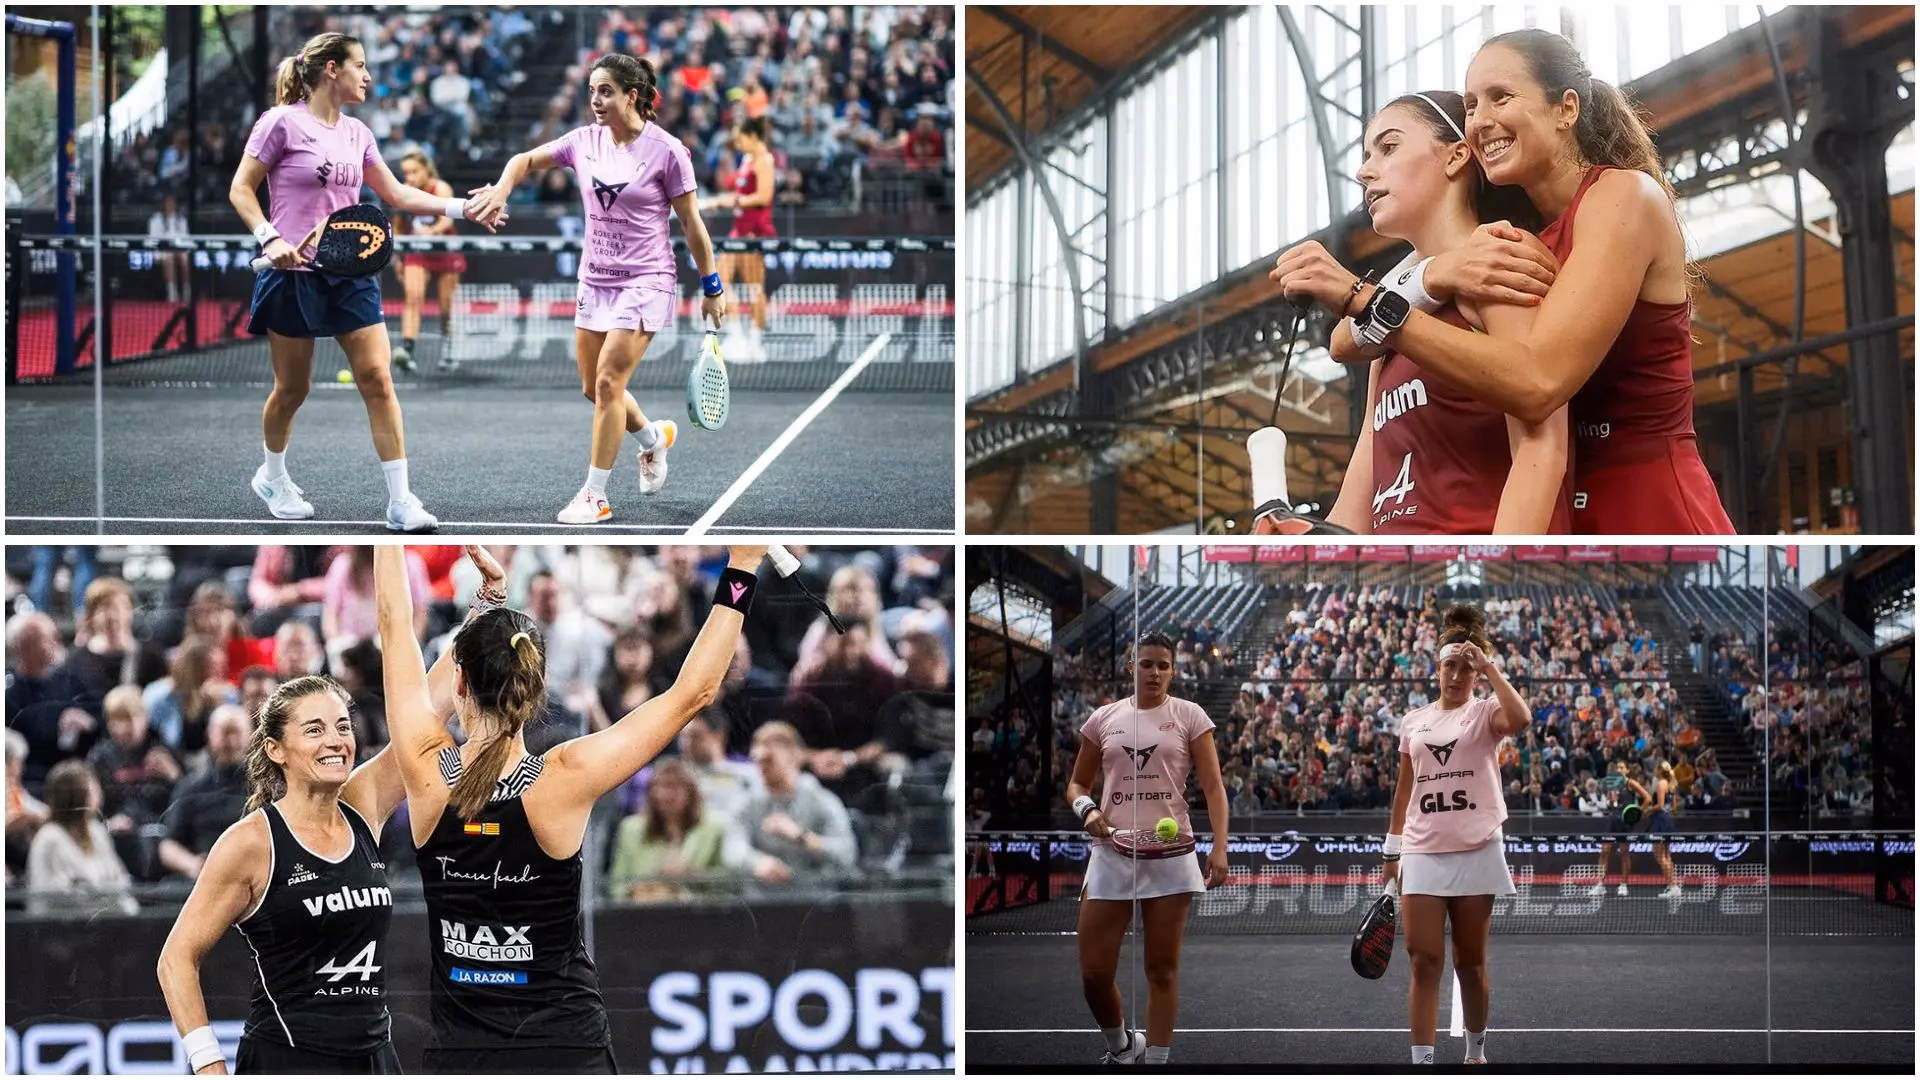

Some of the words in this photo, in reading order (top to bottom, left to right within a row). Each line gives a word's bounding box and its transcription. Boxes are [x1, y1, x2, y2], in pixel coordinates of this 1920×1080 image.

[590, 214, 628, 224] CUPRA
[593, 229, 623, 240] ROBERT
[592, 239, 626, 249] WALTERS
[594, 248, 621, 257] GROUP
[1417, 770, 1474, 783] CUPRA
[1420, 790, 1477, 814] GLS.
[1315, 842, 1385, 854] OFFICIA
[287, 872, 319, 886] PADEL
[302, 886, 393, 917] valum
[440, 919, 531, 946] MAX
[445, 940, 532, 960] COLCHON
[459, 971, 472, 983] LA
[474, 973, 515, 983] RAZON
[314, 986, 380, 996] ALPINE
[648, 967, 955, 1054] SPORT
